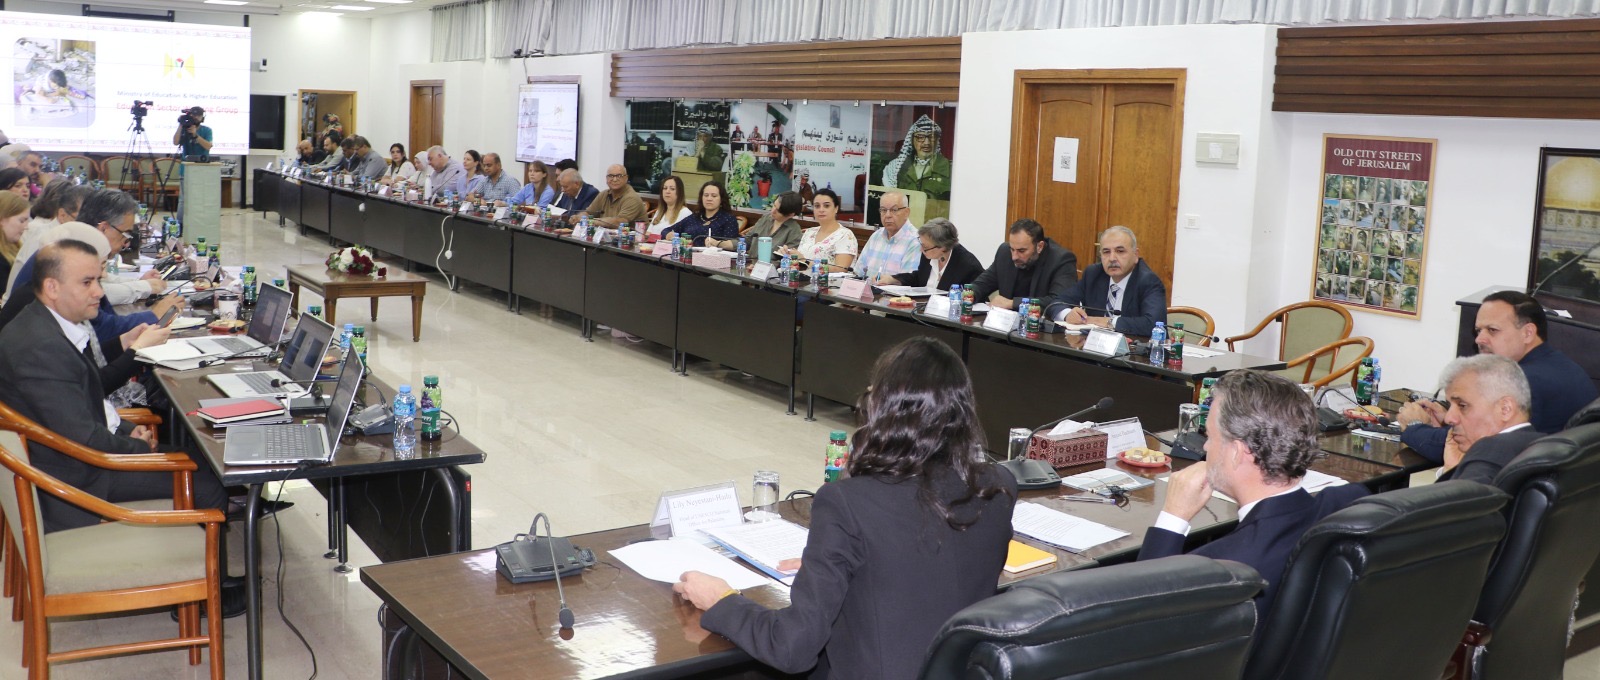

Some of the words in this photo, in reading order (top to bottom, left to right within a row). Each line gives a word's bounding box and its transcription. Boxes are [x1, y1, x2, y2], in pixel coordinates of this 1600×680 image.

[157, 103, 181, 111] Sector
[215, 106, 239, 115] Group
[1333, 147, 1354, 157] OLD
[1355, 149, 1377, 159] CITY
[1379, 150, 1422, 162] STREETS
[1342, 157, 1355, 167] OF
[1356, 158, 1411, 171] JERUSALEM
[672, 500, 685, 510] Lily
